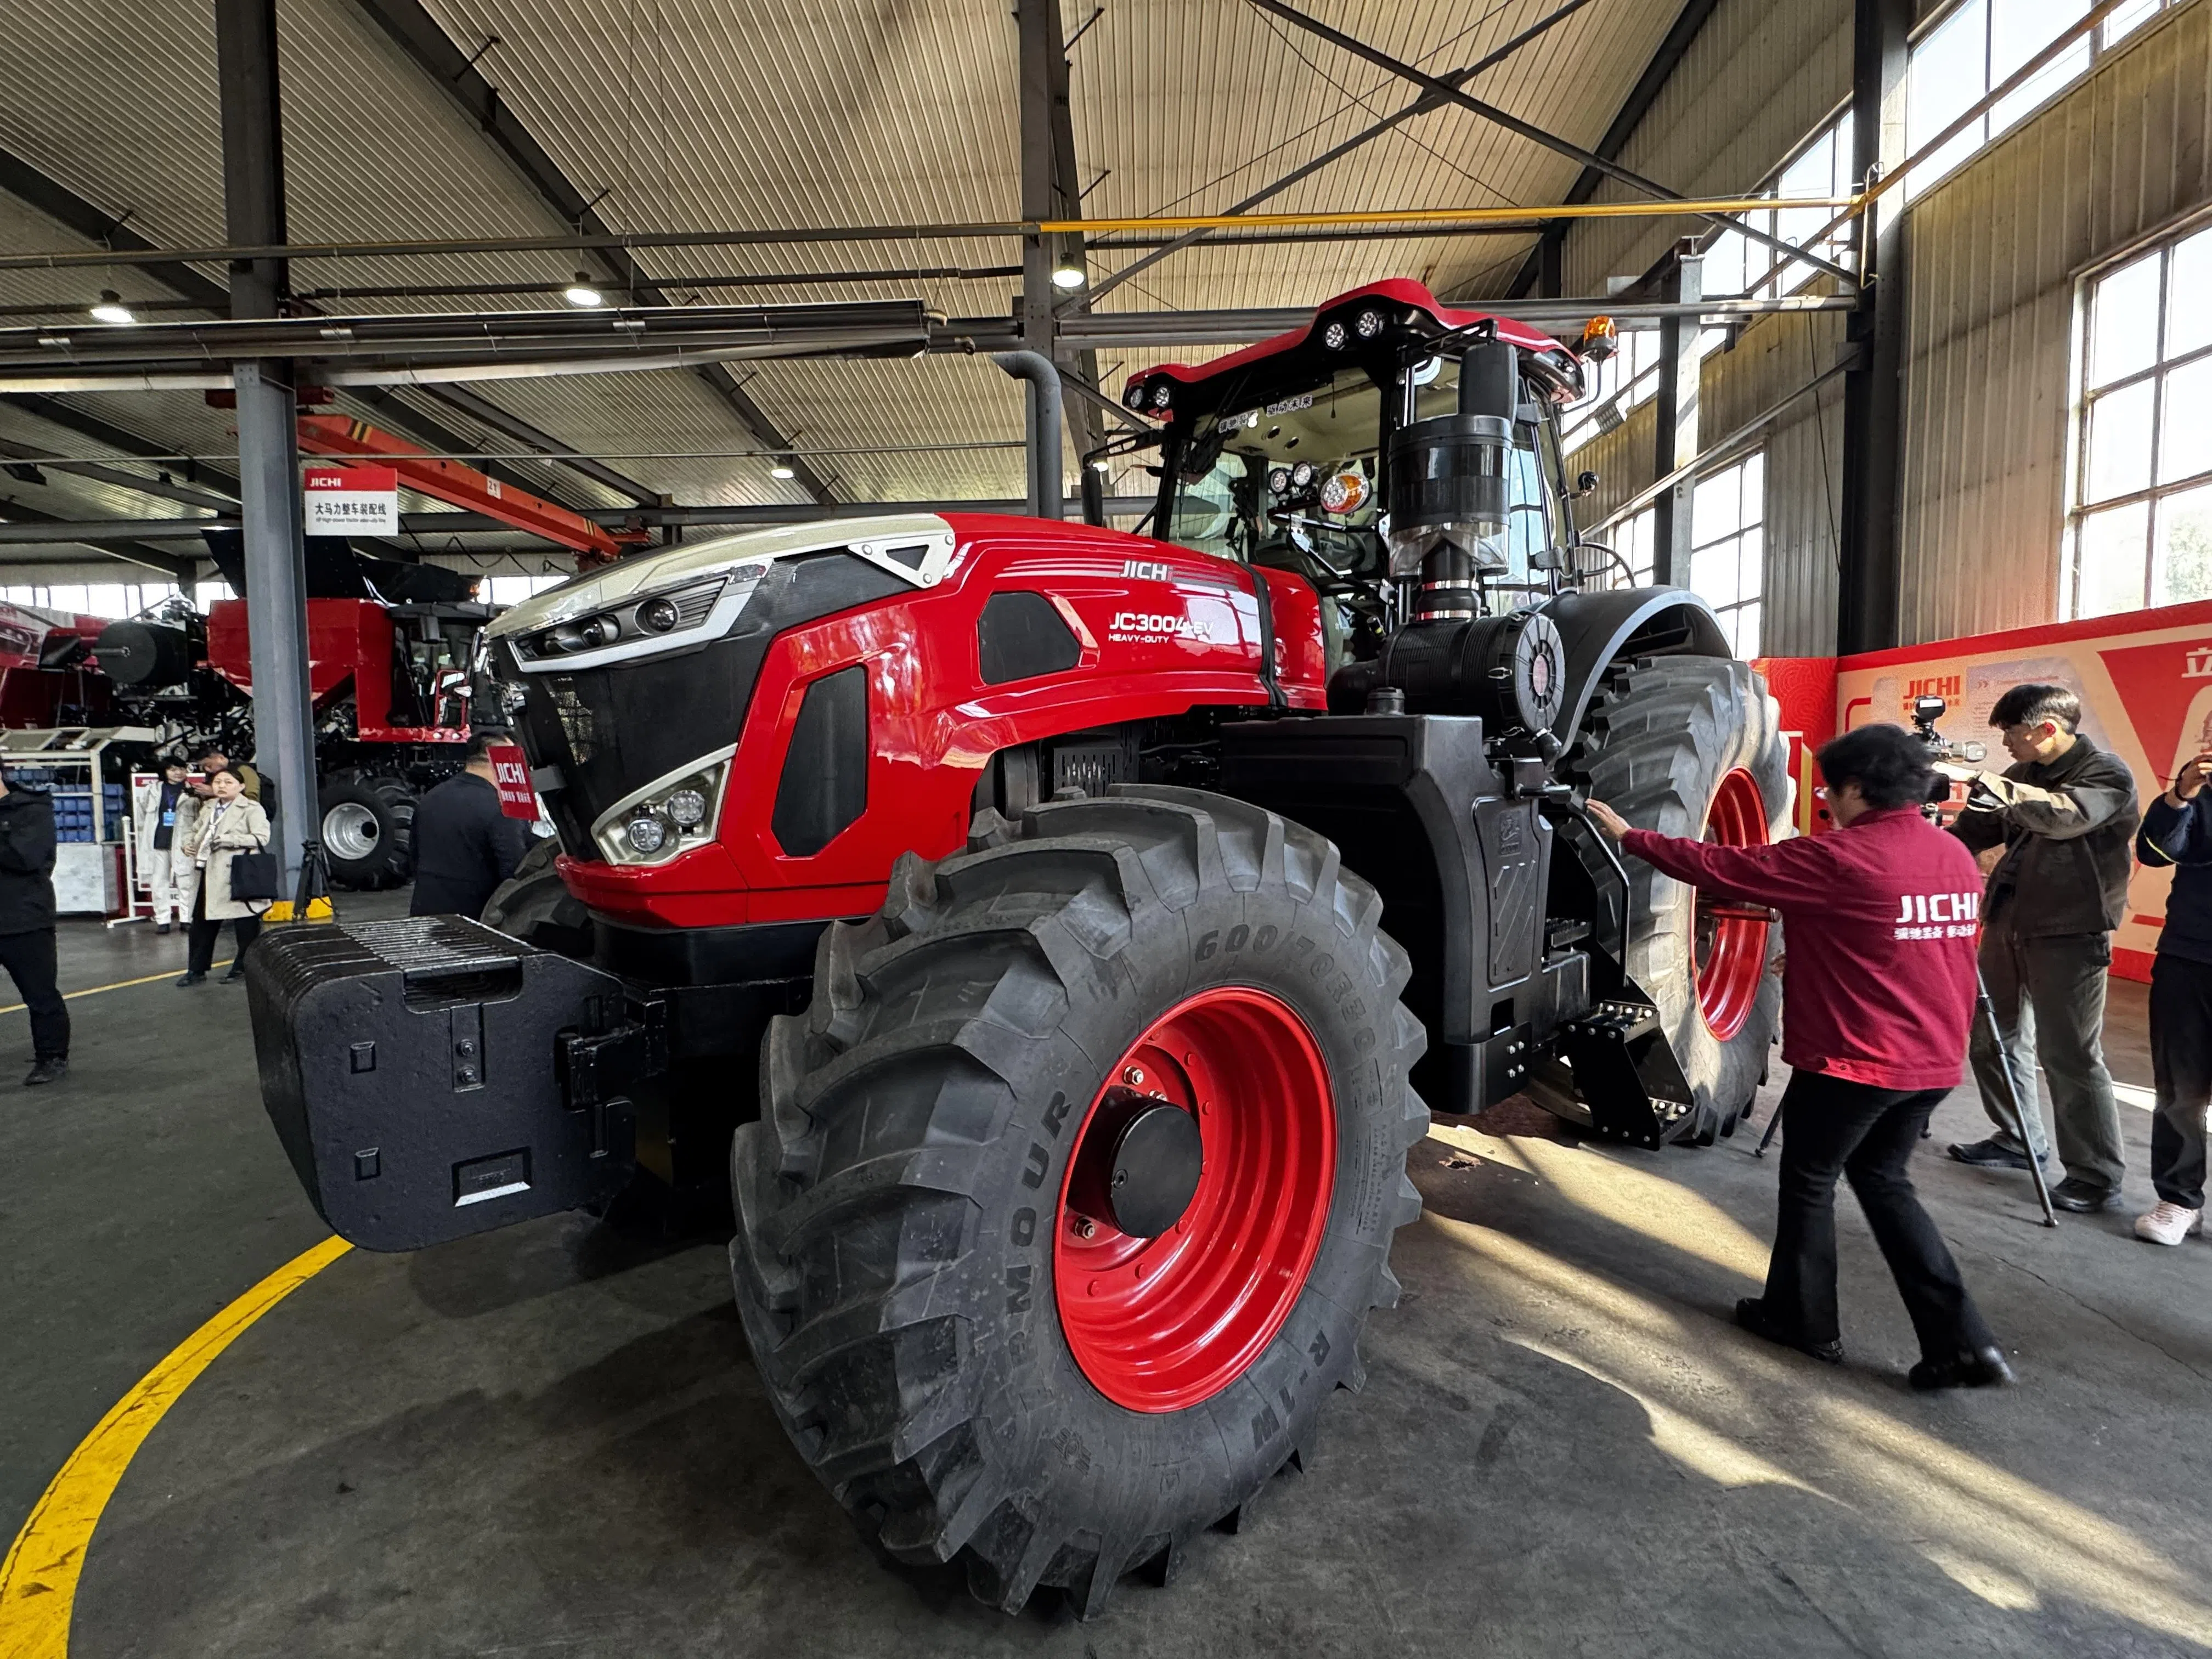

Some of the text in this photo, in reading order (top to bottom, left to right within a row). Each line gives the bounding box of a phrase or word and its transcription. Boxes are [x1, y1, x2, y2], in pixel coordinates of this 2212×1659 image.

[310, 477, 341, 487] JICHI
[315, 503, 386, 515] 大马力整车装配线
[1120, 560, 1173, 582] JICHI
[1109, 612, 1214, 635] JC3004-EV
[1108, 633, 1170, 644] HEAVY-DUTY
[1903, 675, 1961, 699] JICHI
[496, 763, 526, 785] JICHI
[1895, 892, 1978, 923] JICHI
